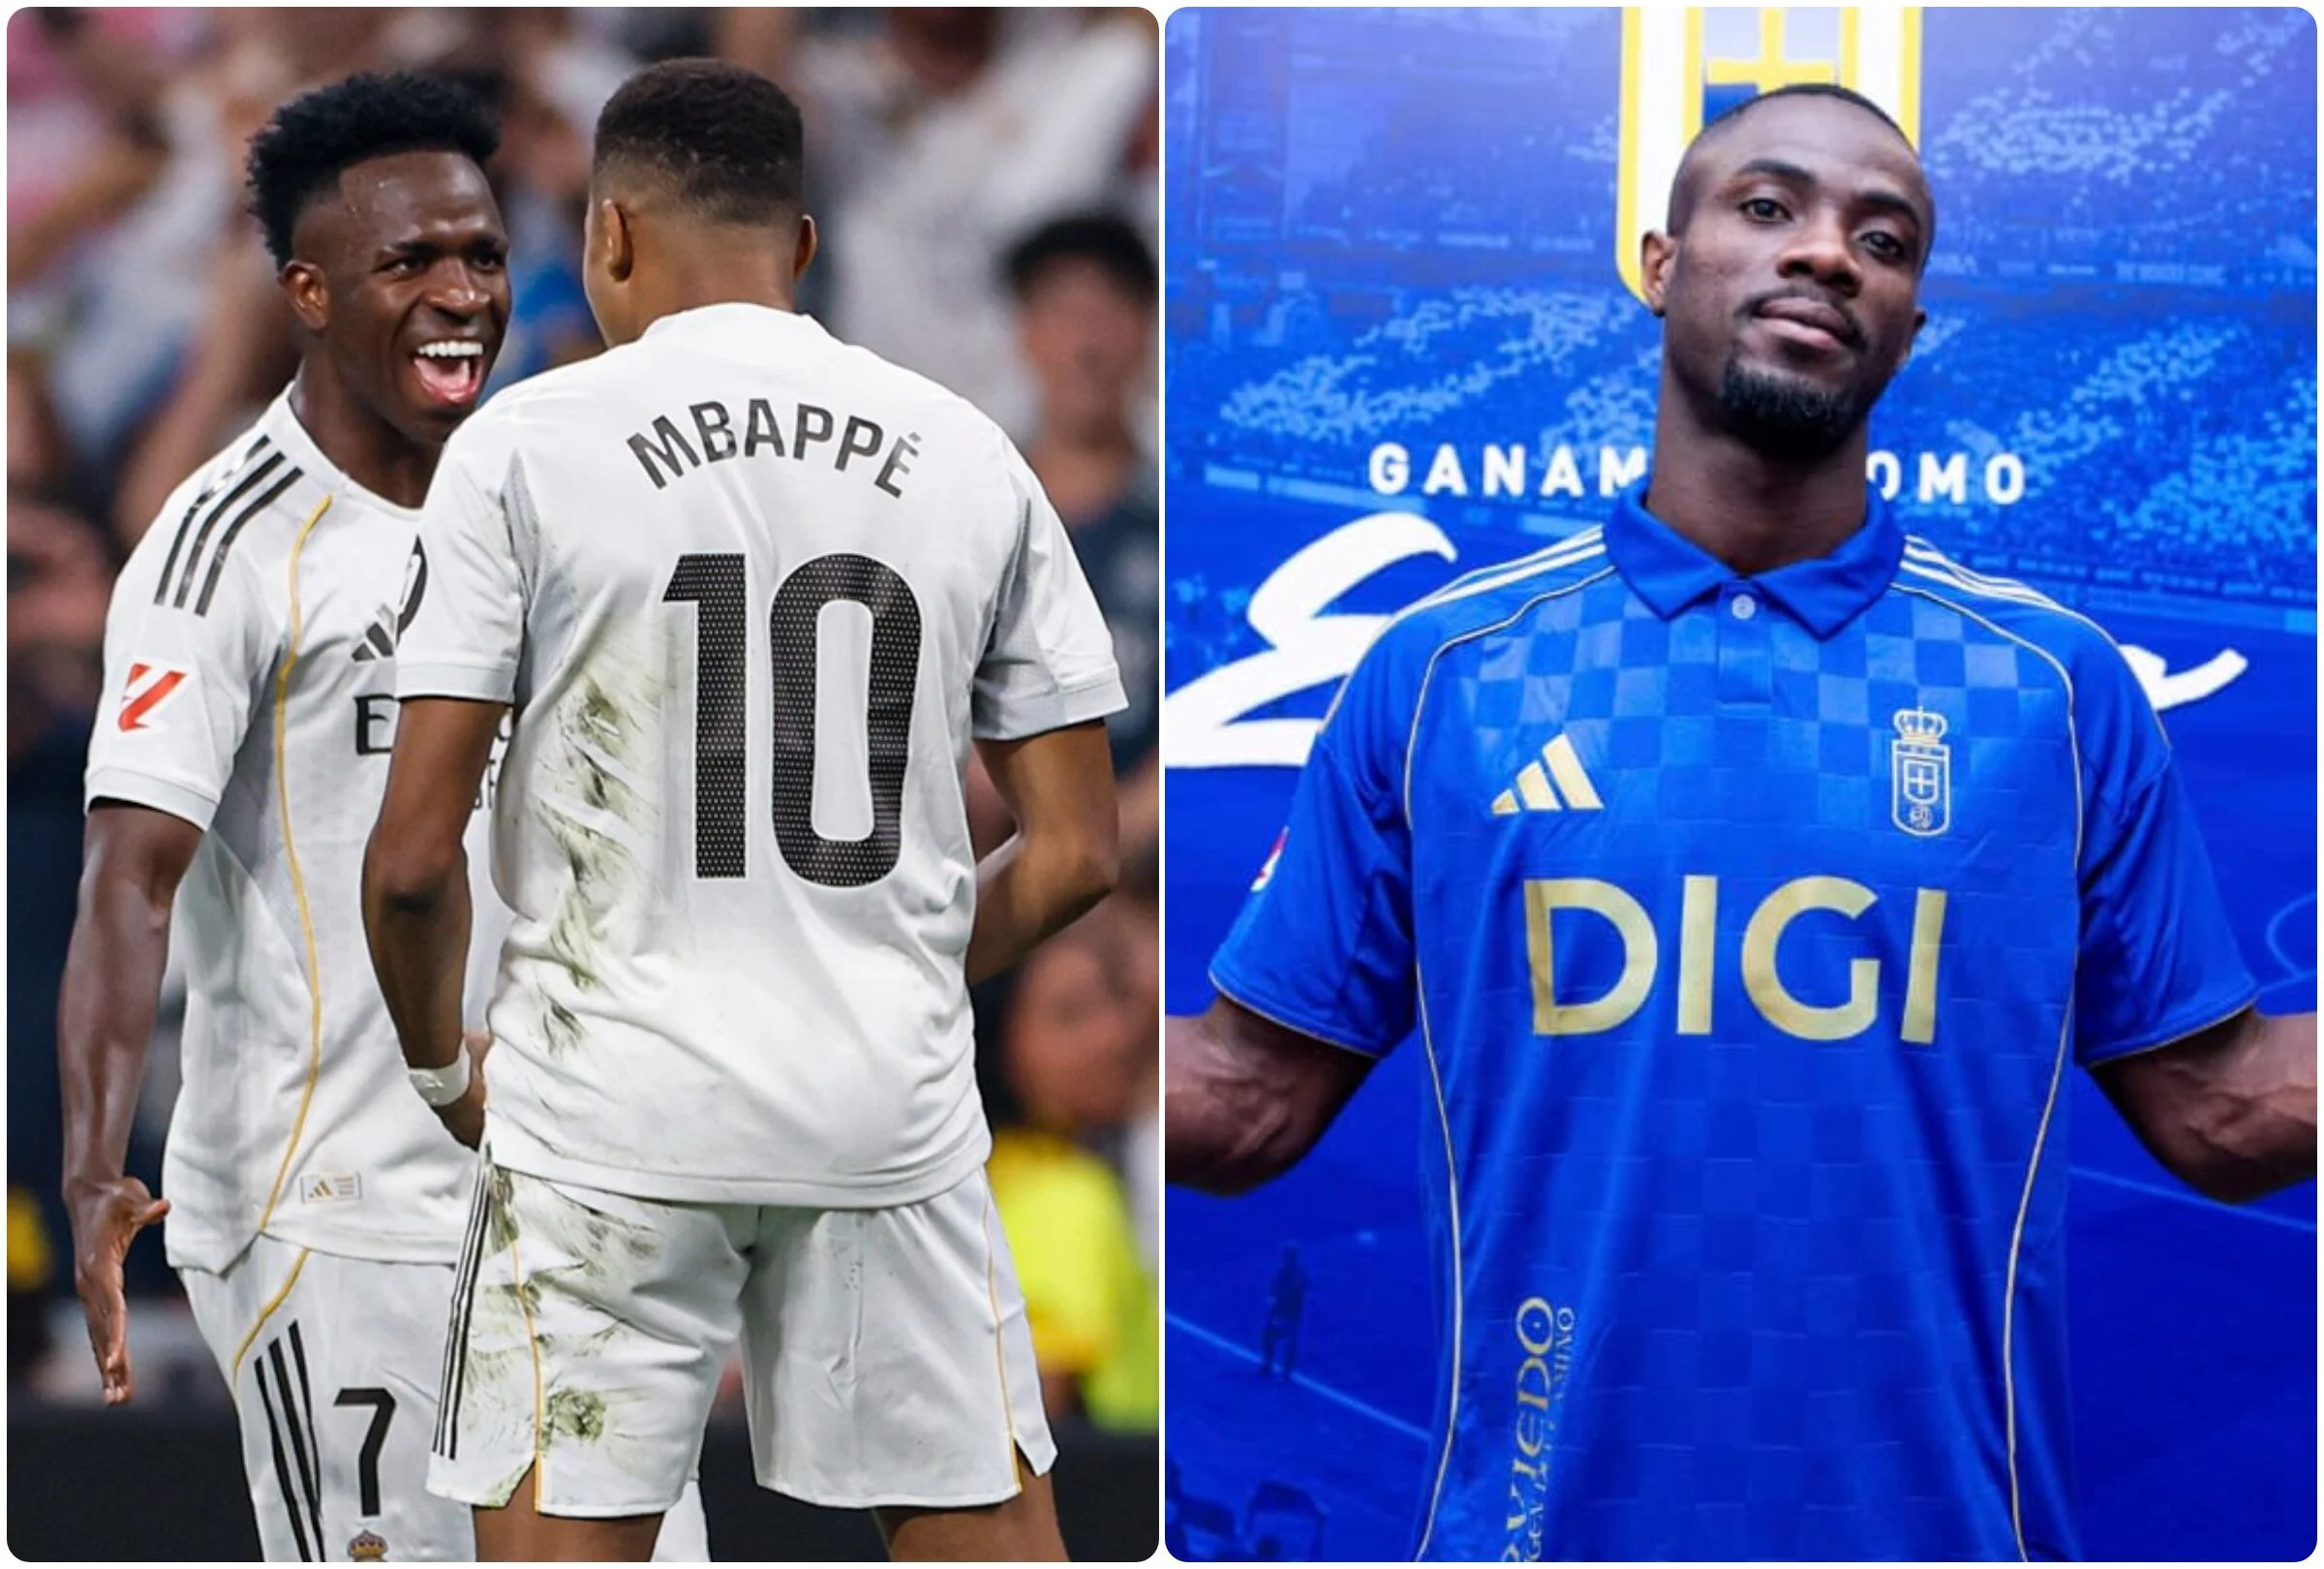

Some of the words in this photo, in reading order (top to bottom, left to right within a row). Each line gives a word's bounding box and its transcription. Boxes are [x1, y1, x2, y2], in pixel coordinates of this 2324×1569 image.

[627, 398, 923, 499] MBAPPÉ
[1368, 442, 1646, 498] GANAM
[1865, 449, 2027, 505] OMO
[661, 552, 923, 889] 10
[1523, 874, 1947, 1045] DIGI
[333, 1387, 397, 1518] 7
